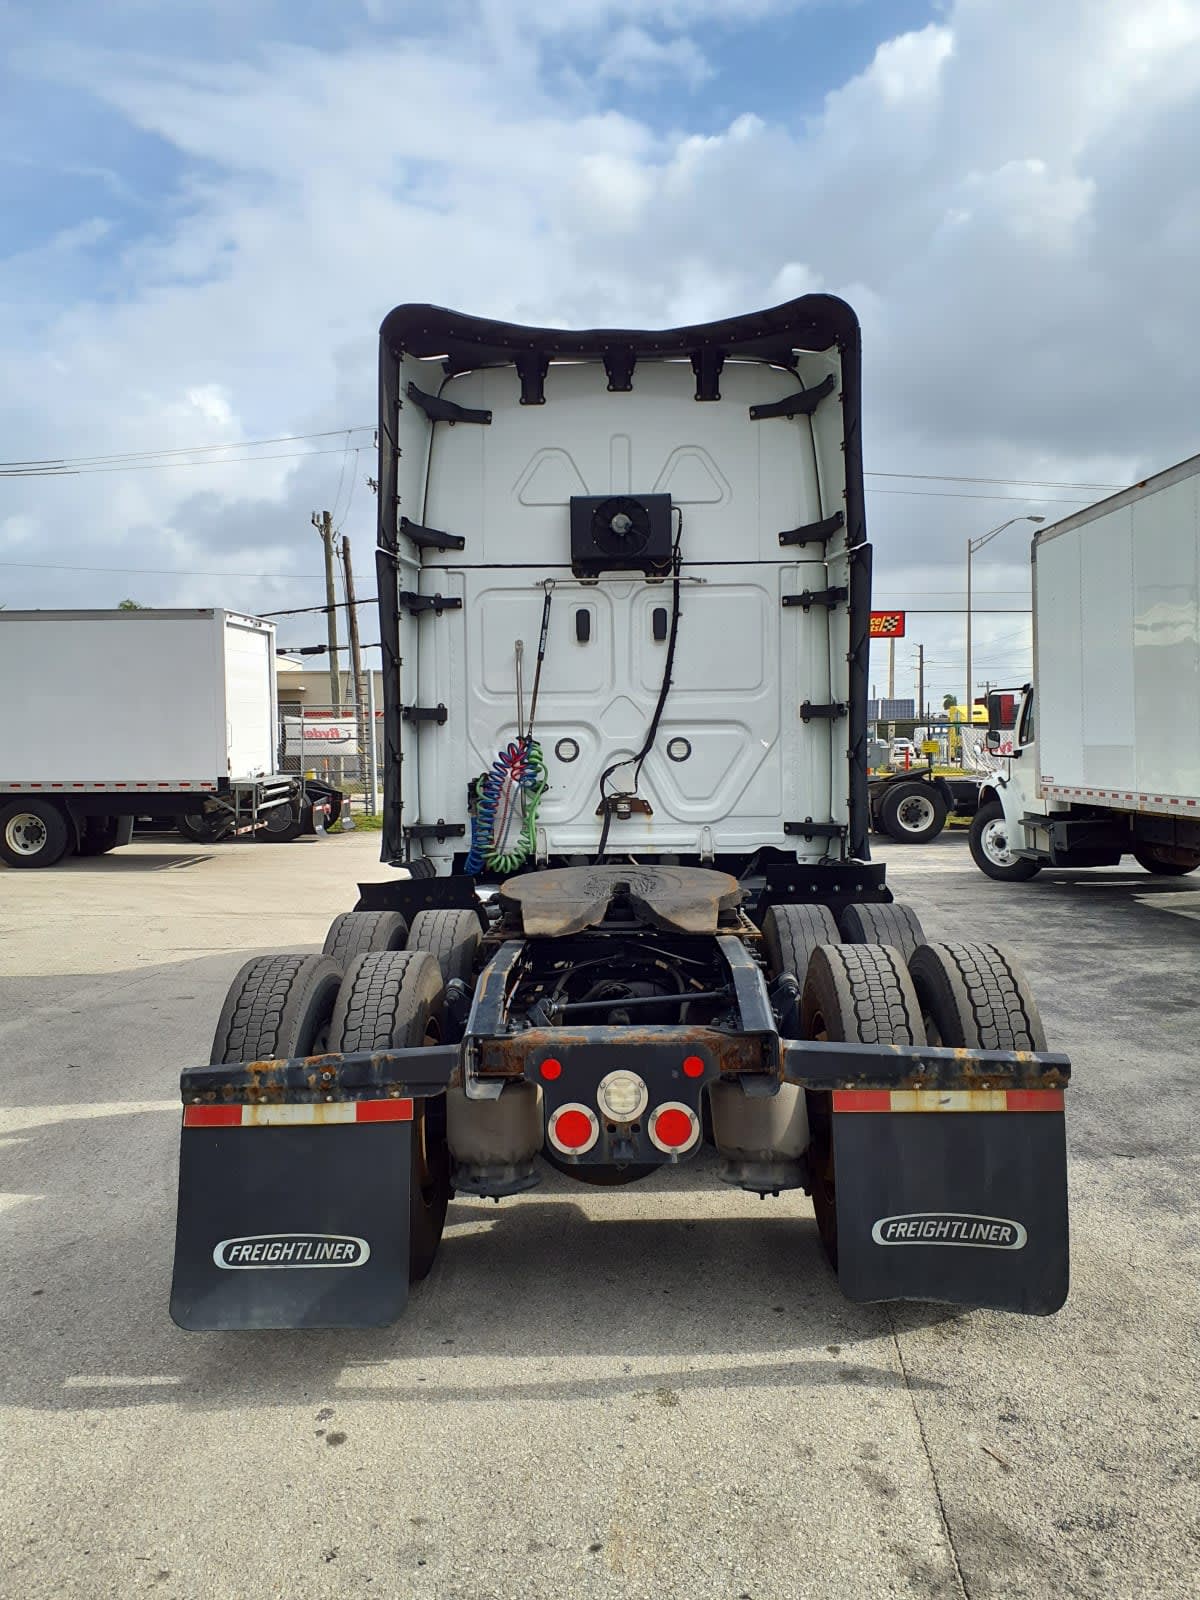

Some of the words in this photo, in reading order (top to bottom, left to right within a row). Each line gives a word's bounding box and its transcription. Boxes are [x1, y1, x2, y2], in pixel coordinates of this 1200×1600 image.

[870, 617, 881, 625] ce
[887, 1220, 1012, 1242] FREIGHTLINER
[228, 1242, 355, 1262] FREIGHTLINER
